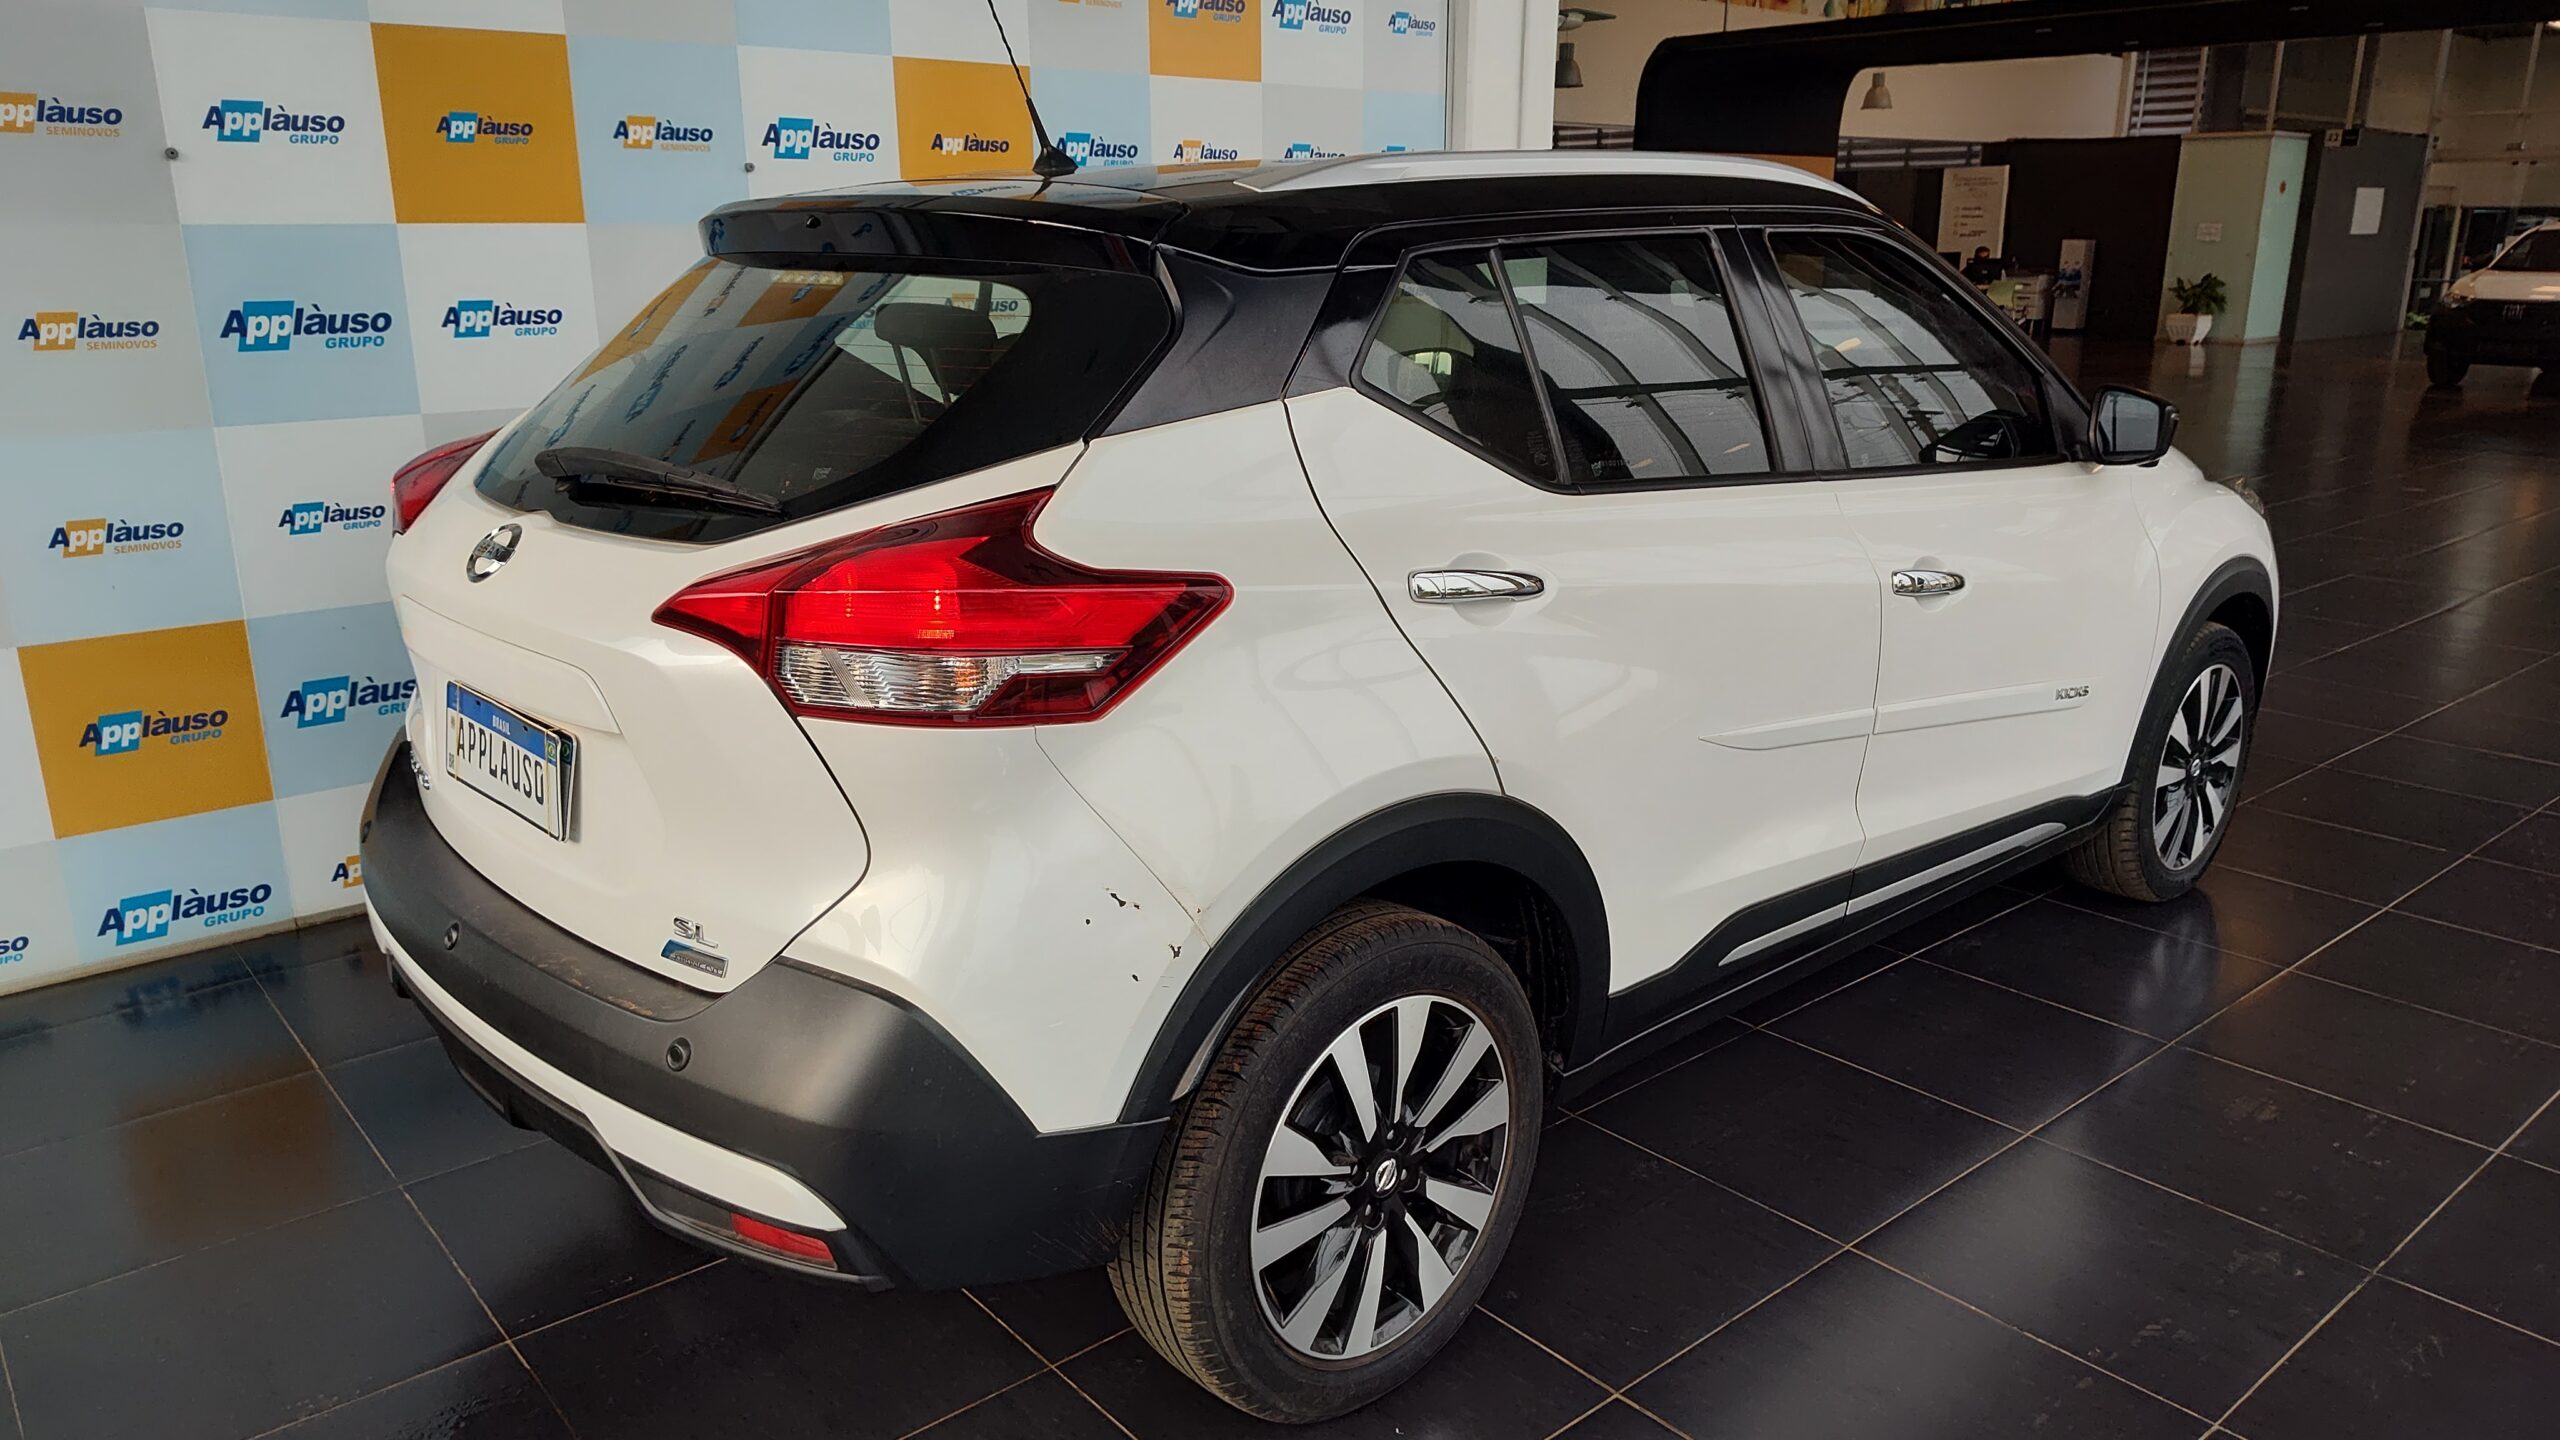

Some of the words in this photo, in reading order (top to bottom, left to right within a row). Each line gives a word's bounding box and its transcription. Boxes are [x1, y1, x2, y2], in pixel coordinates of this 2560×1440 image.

[1318, 24, 1347, 34] GRUPO
[0, 97, 123, 127] pplàuso
[202, 105, 345, 136] Applàuso
[46, 126, 120, 137] SEMINOVOS
[289, 133, 339, 145] GRUPO
[495, 136, 529, 145] GRUPO
[762, 123, 880, 155] Applàuso
[833, 152, 875, 163] GRUPO
[18, 314, 159, 345] Applàuso
[220, 303, 392, 345] Applàuso
[441, 302, 563, 333] Applàuso
[325, 336, 385, 349] GRUPO
[514, 326, 558, 337] GRUPO
[86, 340, 157, 351] SEMINOVOS
[278, 503, 386, 530] Applàuso
[343, 519, 382, 531] GRUPO
[48, 519, 184, 549] Applàuso
[114, 540, 182, 555] SEMINOVOS
[281, 676, 416, 721] Applàus
[378, 702, 406, 715] GRU
[79, 710, 228, 750] Applàuso
[170, 729, 222, 745] GRUPO
[457, 717, 544, 806] APPLAUSO
[97, 884, 272, 938] Applàuso
[204, 905, 265, 928] GRUPO
[674, 917, 718, 949] SL
